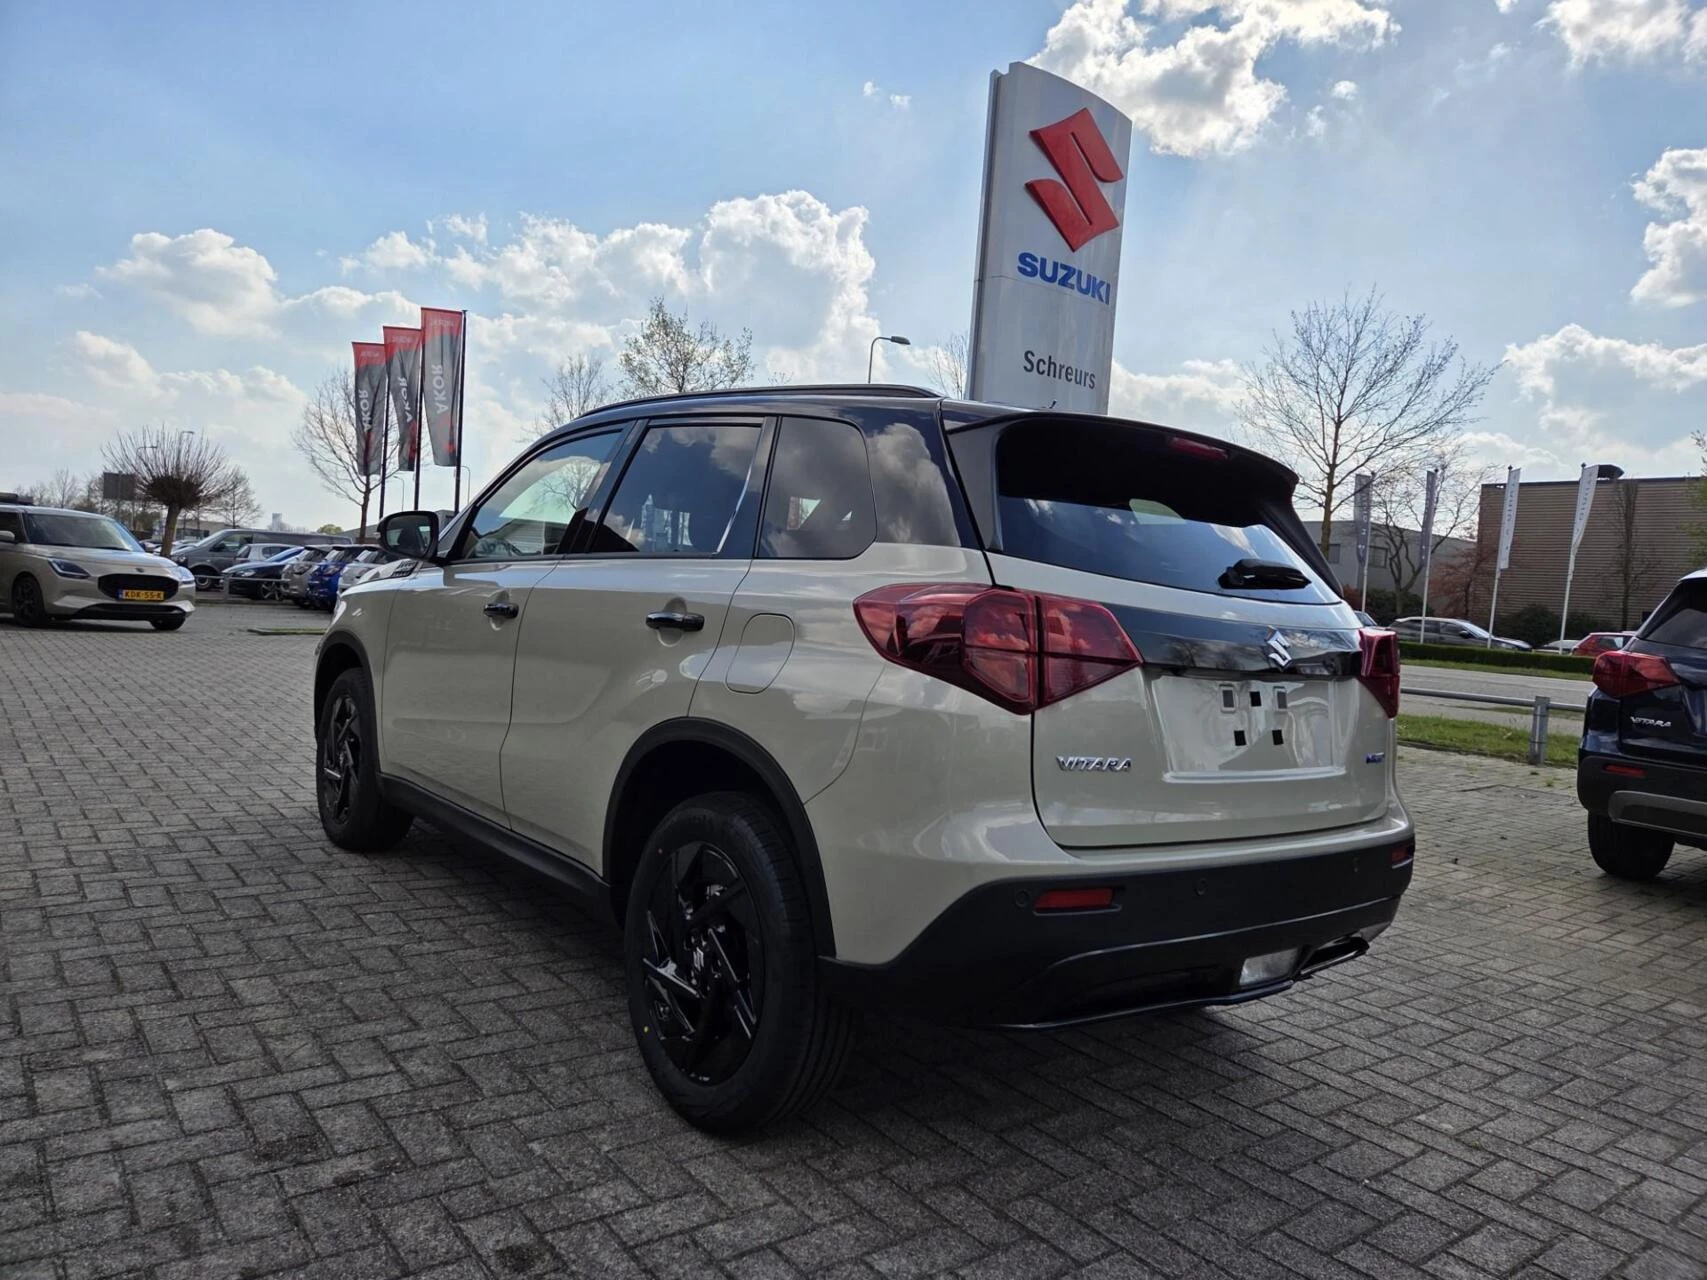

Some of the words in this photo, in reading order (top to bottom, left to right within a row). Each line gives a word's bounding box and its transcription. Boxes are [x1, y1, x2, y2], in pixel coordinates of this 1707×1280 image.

[1017, 252, 1111, 305] SUZUKI
[1023, 350, 1096, 390] Schreurs
[1630, 716, 1671, 727] VITARA
[1056, 756, 1132, 772] VITARA
